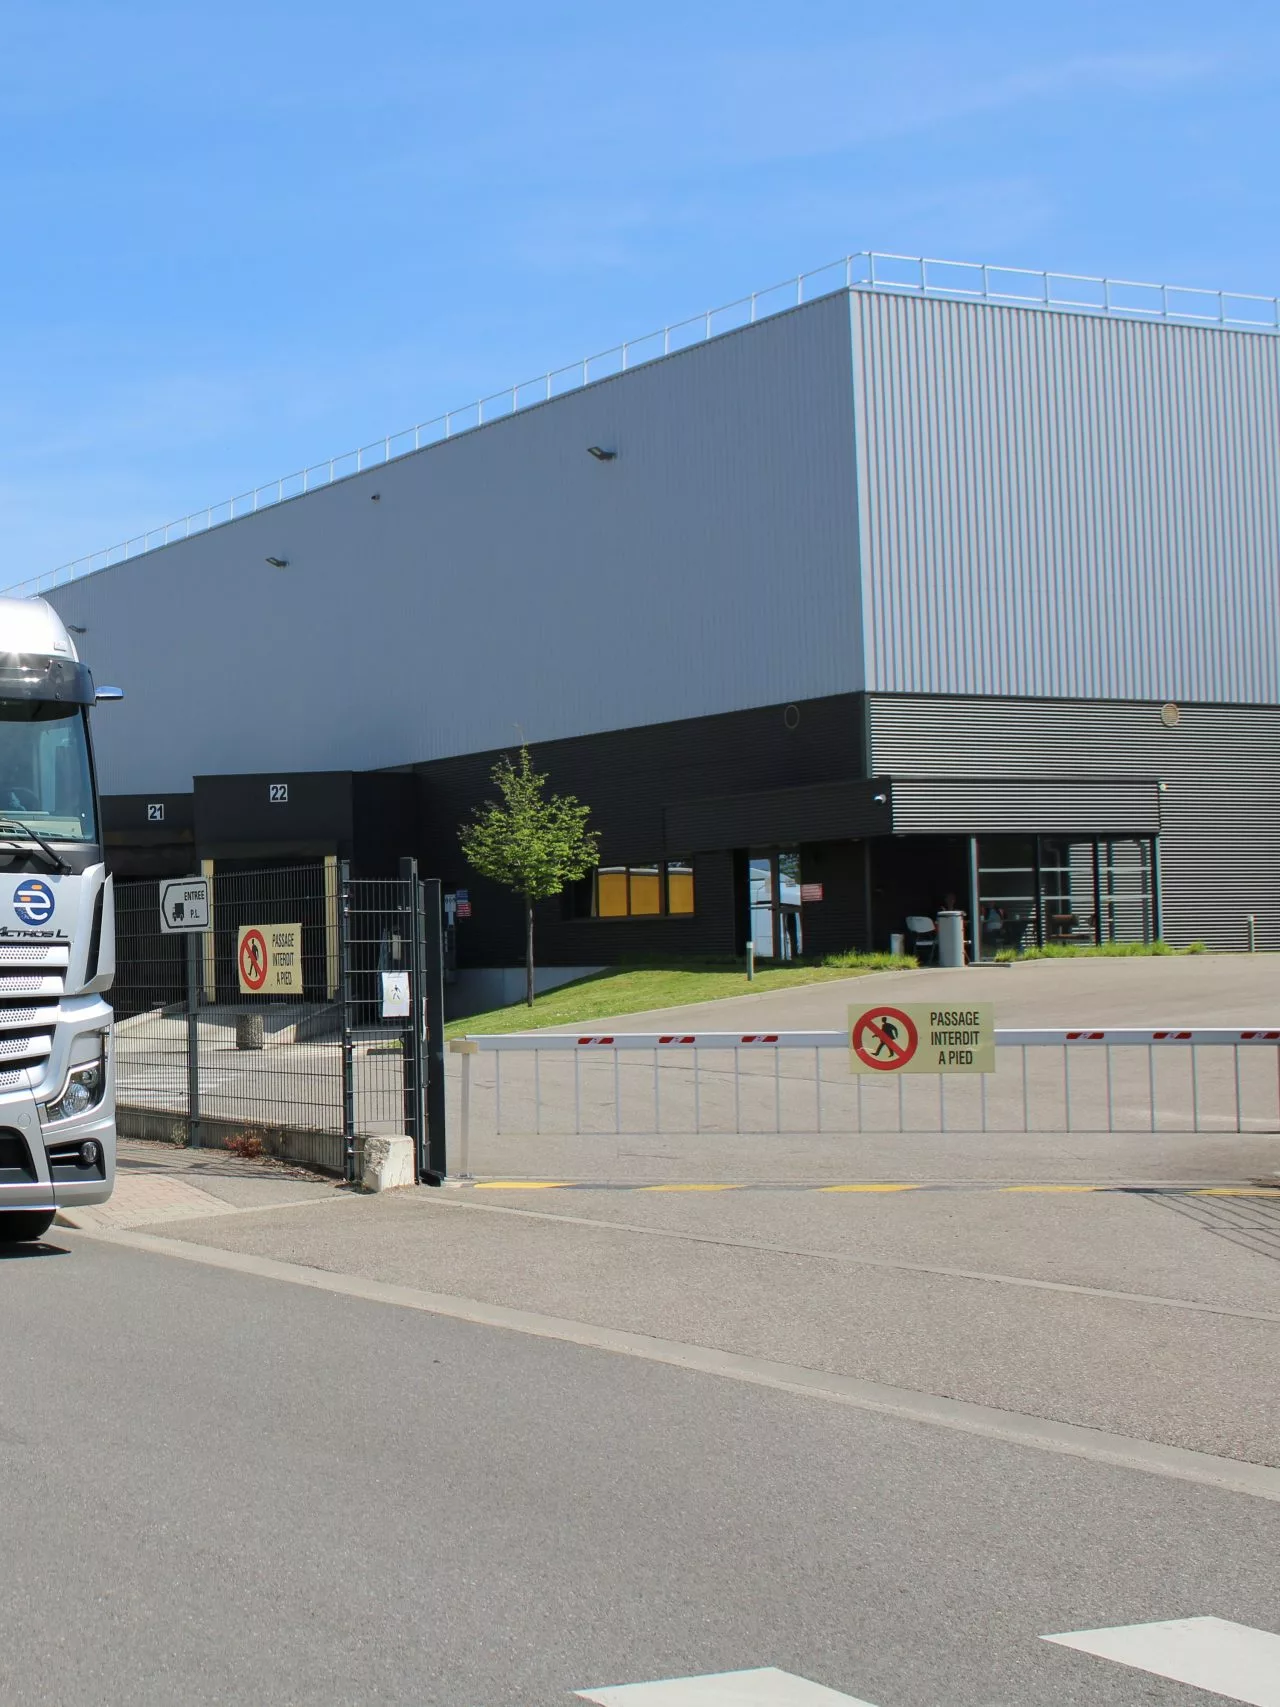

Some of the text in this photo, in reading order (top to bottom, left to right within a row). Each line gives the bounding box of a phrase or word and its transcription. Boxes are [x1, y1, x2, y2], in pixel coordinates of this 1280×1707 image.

[271, 785, 287, 801] 22
[149, 805, 163, 819] 21
[56, 929, 69, 938] L
[272, 933, 295, 947] PASSAGE
[272, 952, 295, 966] INTERDIT
[281, 971, 293, 985] PIED
[930, 1012, 980, 1026] PASSAGE
[931, 1031, 980, 1046] INTERDIT
[938, 1050, 973, 1065] A PIED
